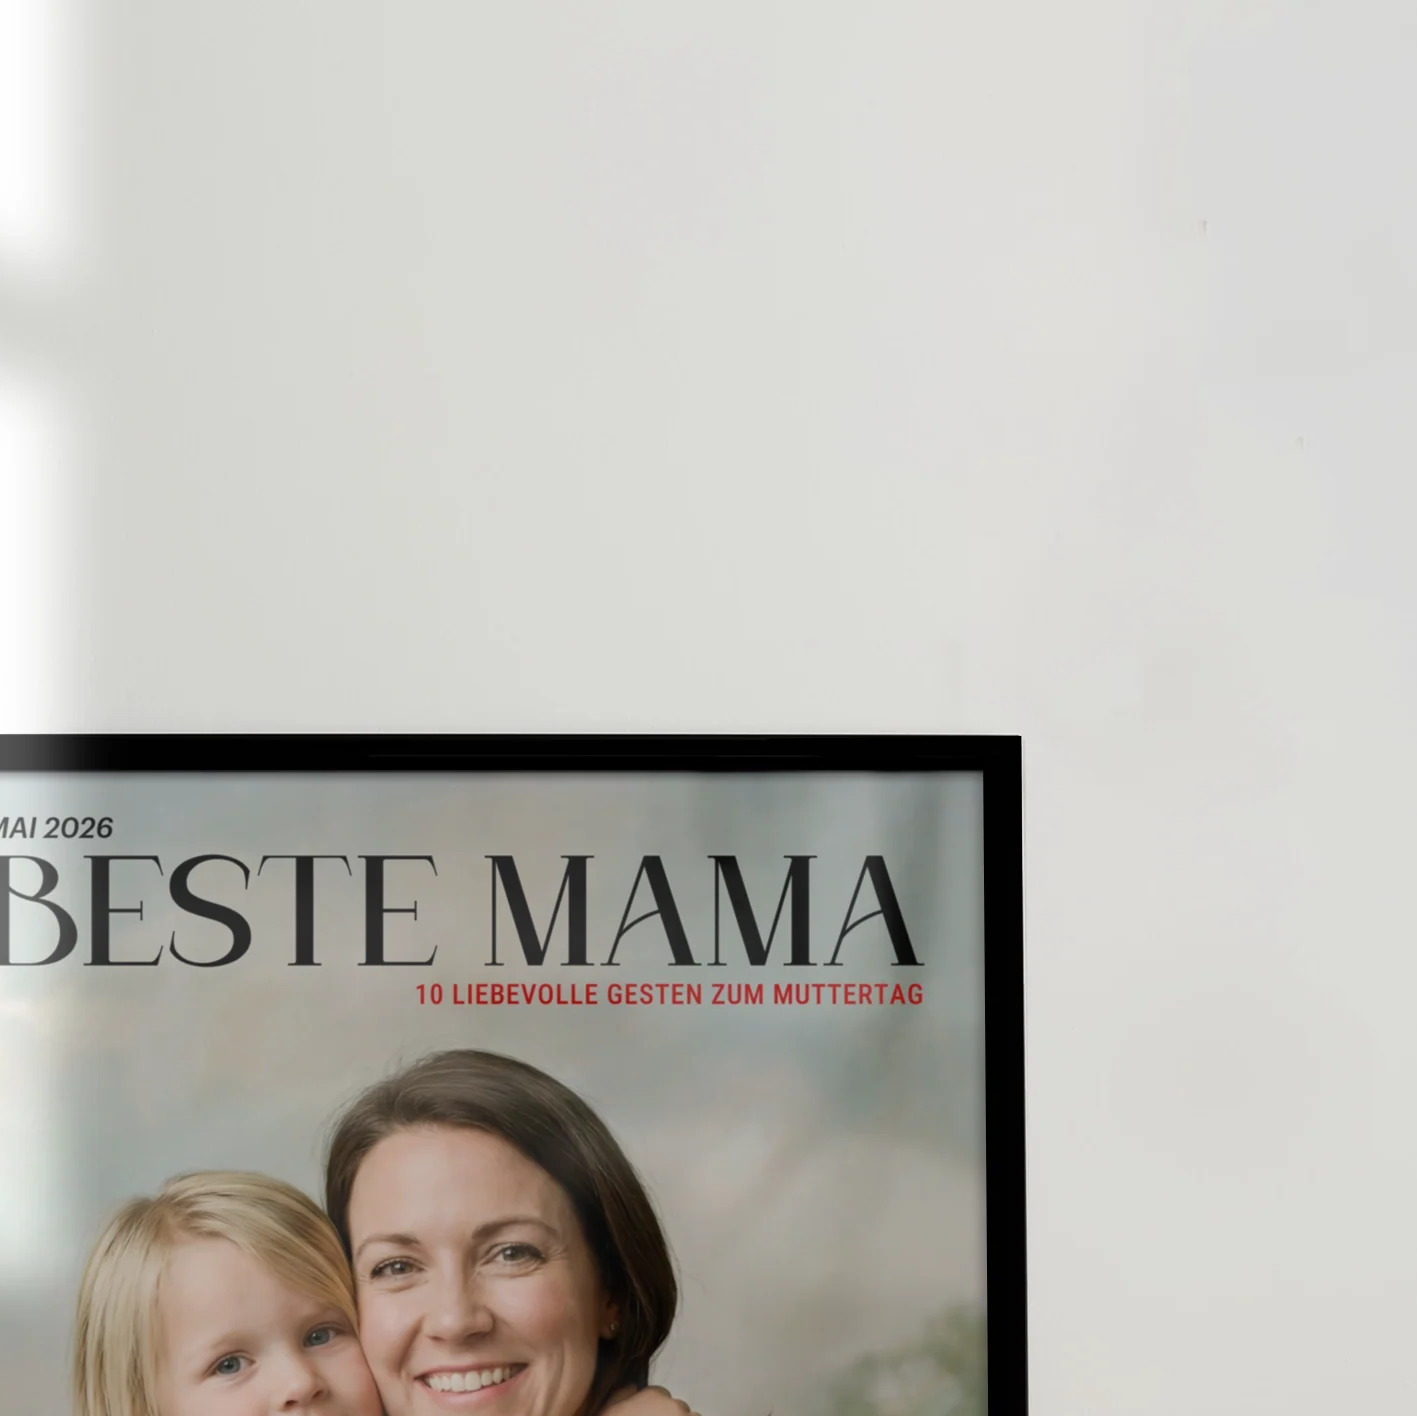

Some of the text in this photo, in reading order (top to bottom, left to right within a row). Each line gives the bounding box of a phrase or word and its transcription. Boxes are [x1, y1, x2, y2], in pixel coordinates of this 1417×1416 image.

[44, 817, 113, 839] 2026
[485, 854, 925, 966] MAMA
[416, 984, 924, 1005] 10 LIEBEVOLLE GESTEN ZUM MUTTERTAG
